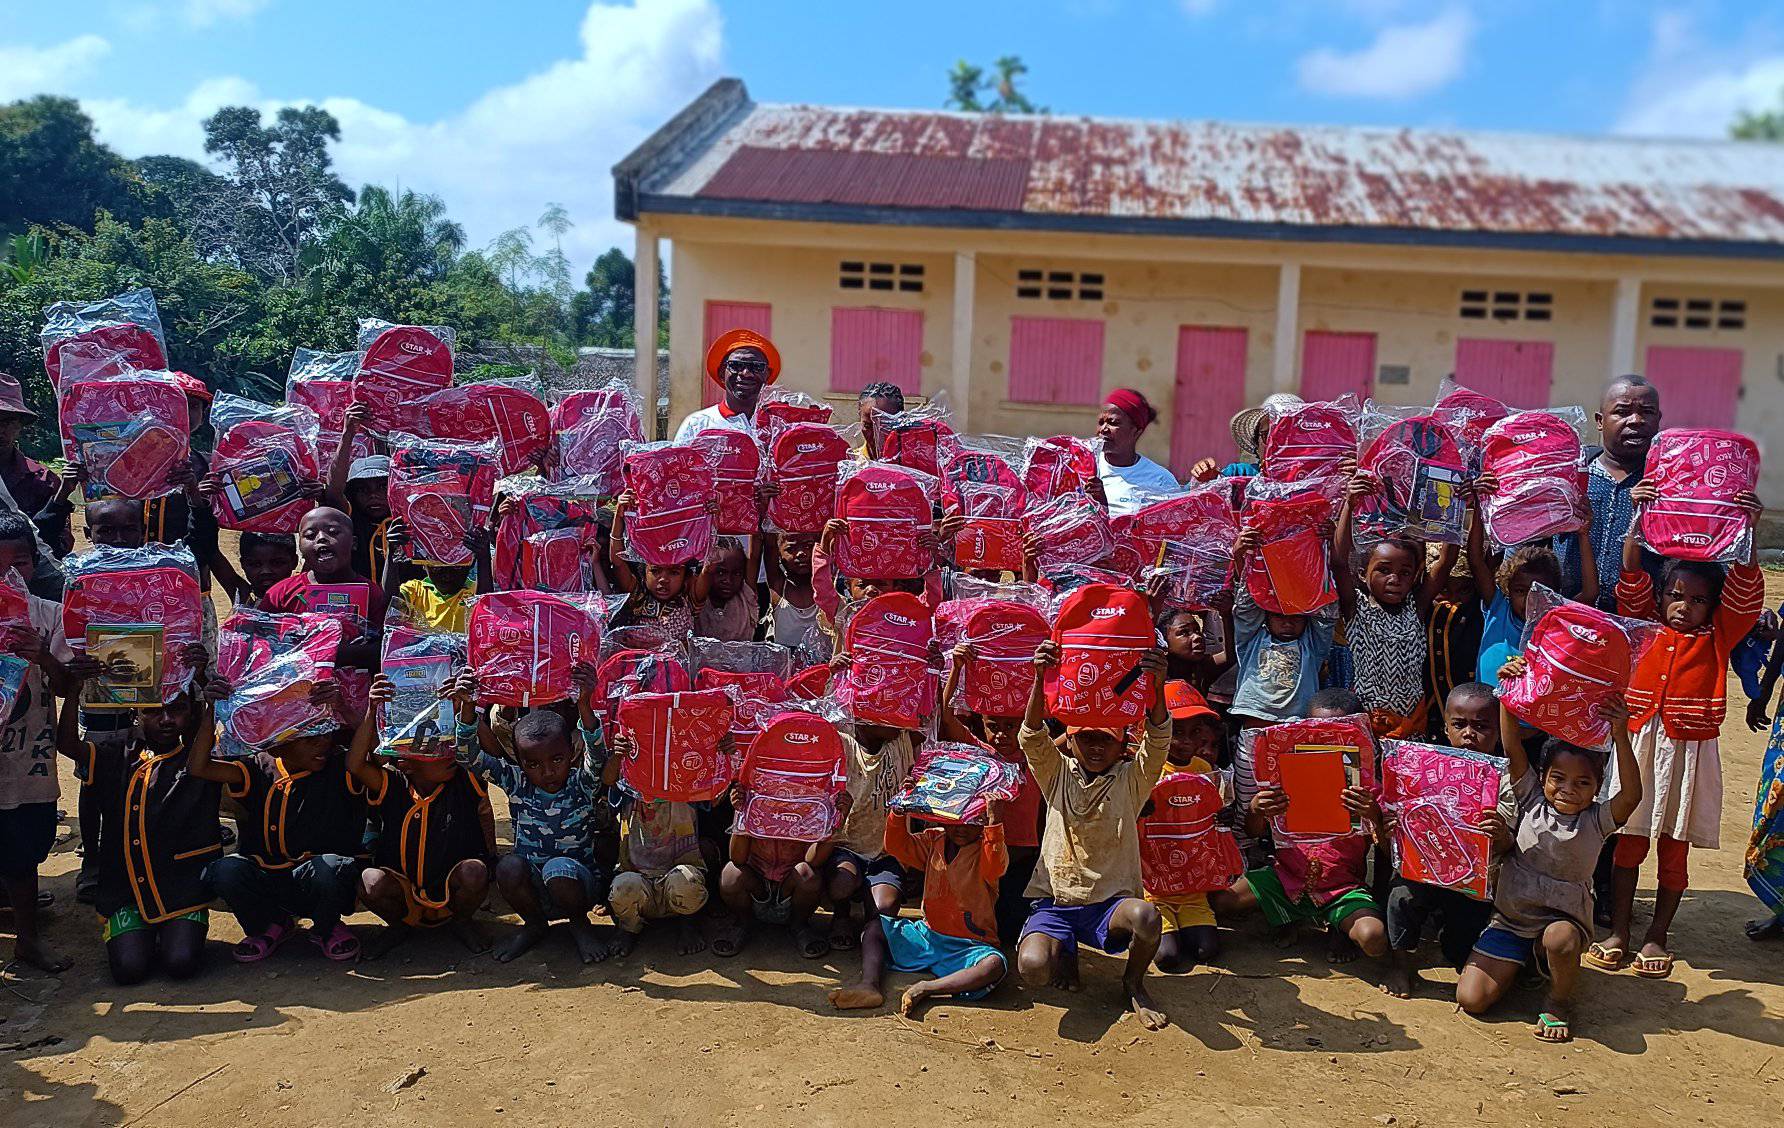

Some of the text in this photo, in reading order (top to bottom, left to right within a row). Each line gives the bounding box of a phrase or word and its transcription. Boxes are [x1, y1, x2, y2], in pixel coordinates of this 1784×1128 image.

[404, 343, 424, 352] STAR
[526, 414, 537, 431] STAR
[1515, 432, 1536, 441] STAR
[1682, 535, 1706, 545] STAR
[668, 541, 685, 550] STAR
[889, 613, 908, 623] STAR
[1572, 625, 1598, 641] STAR
